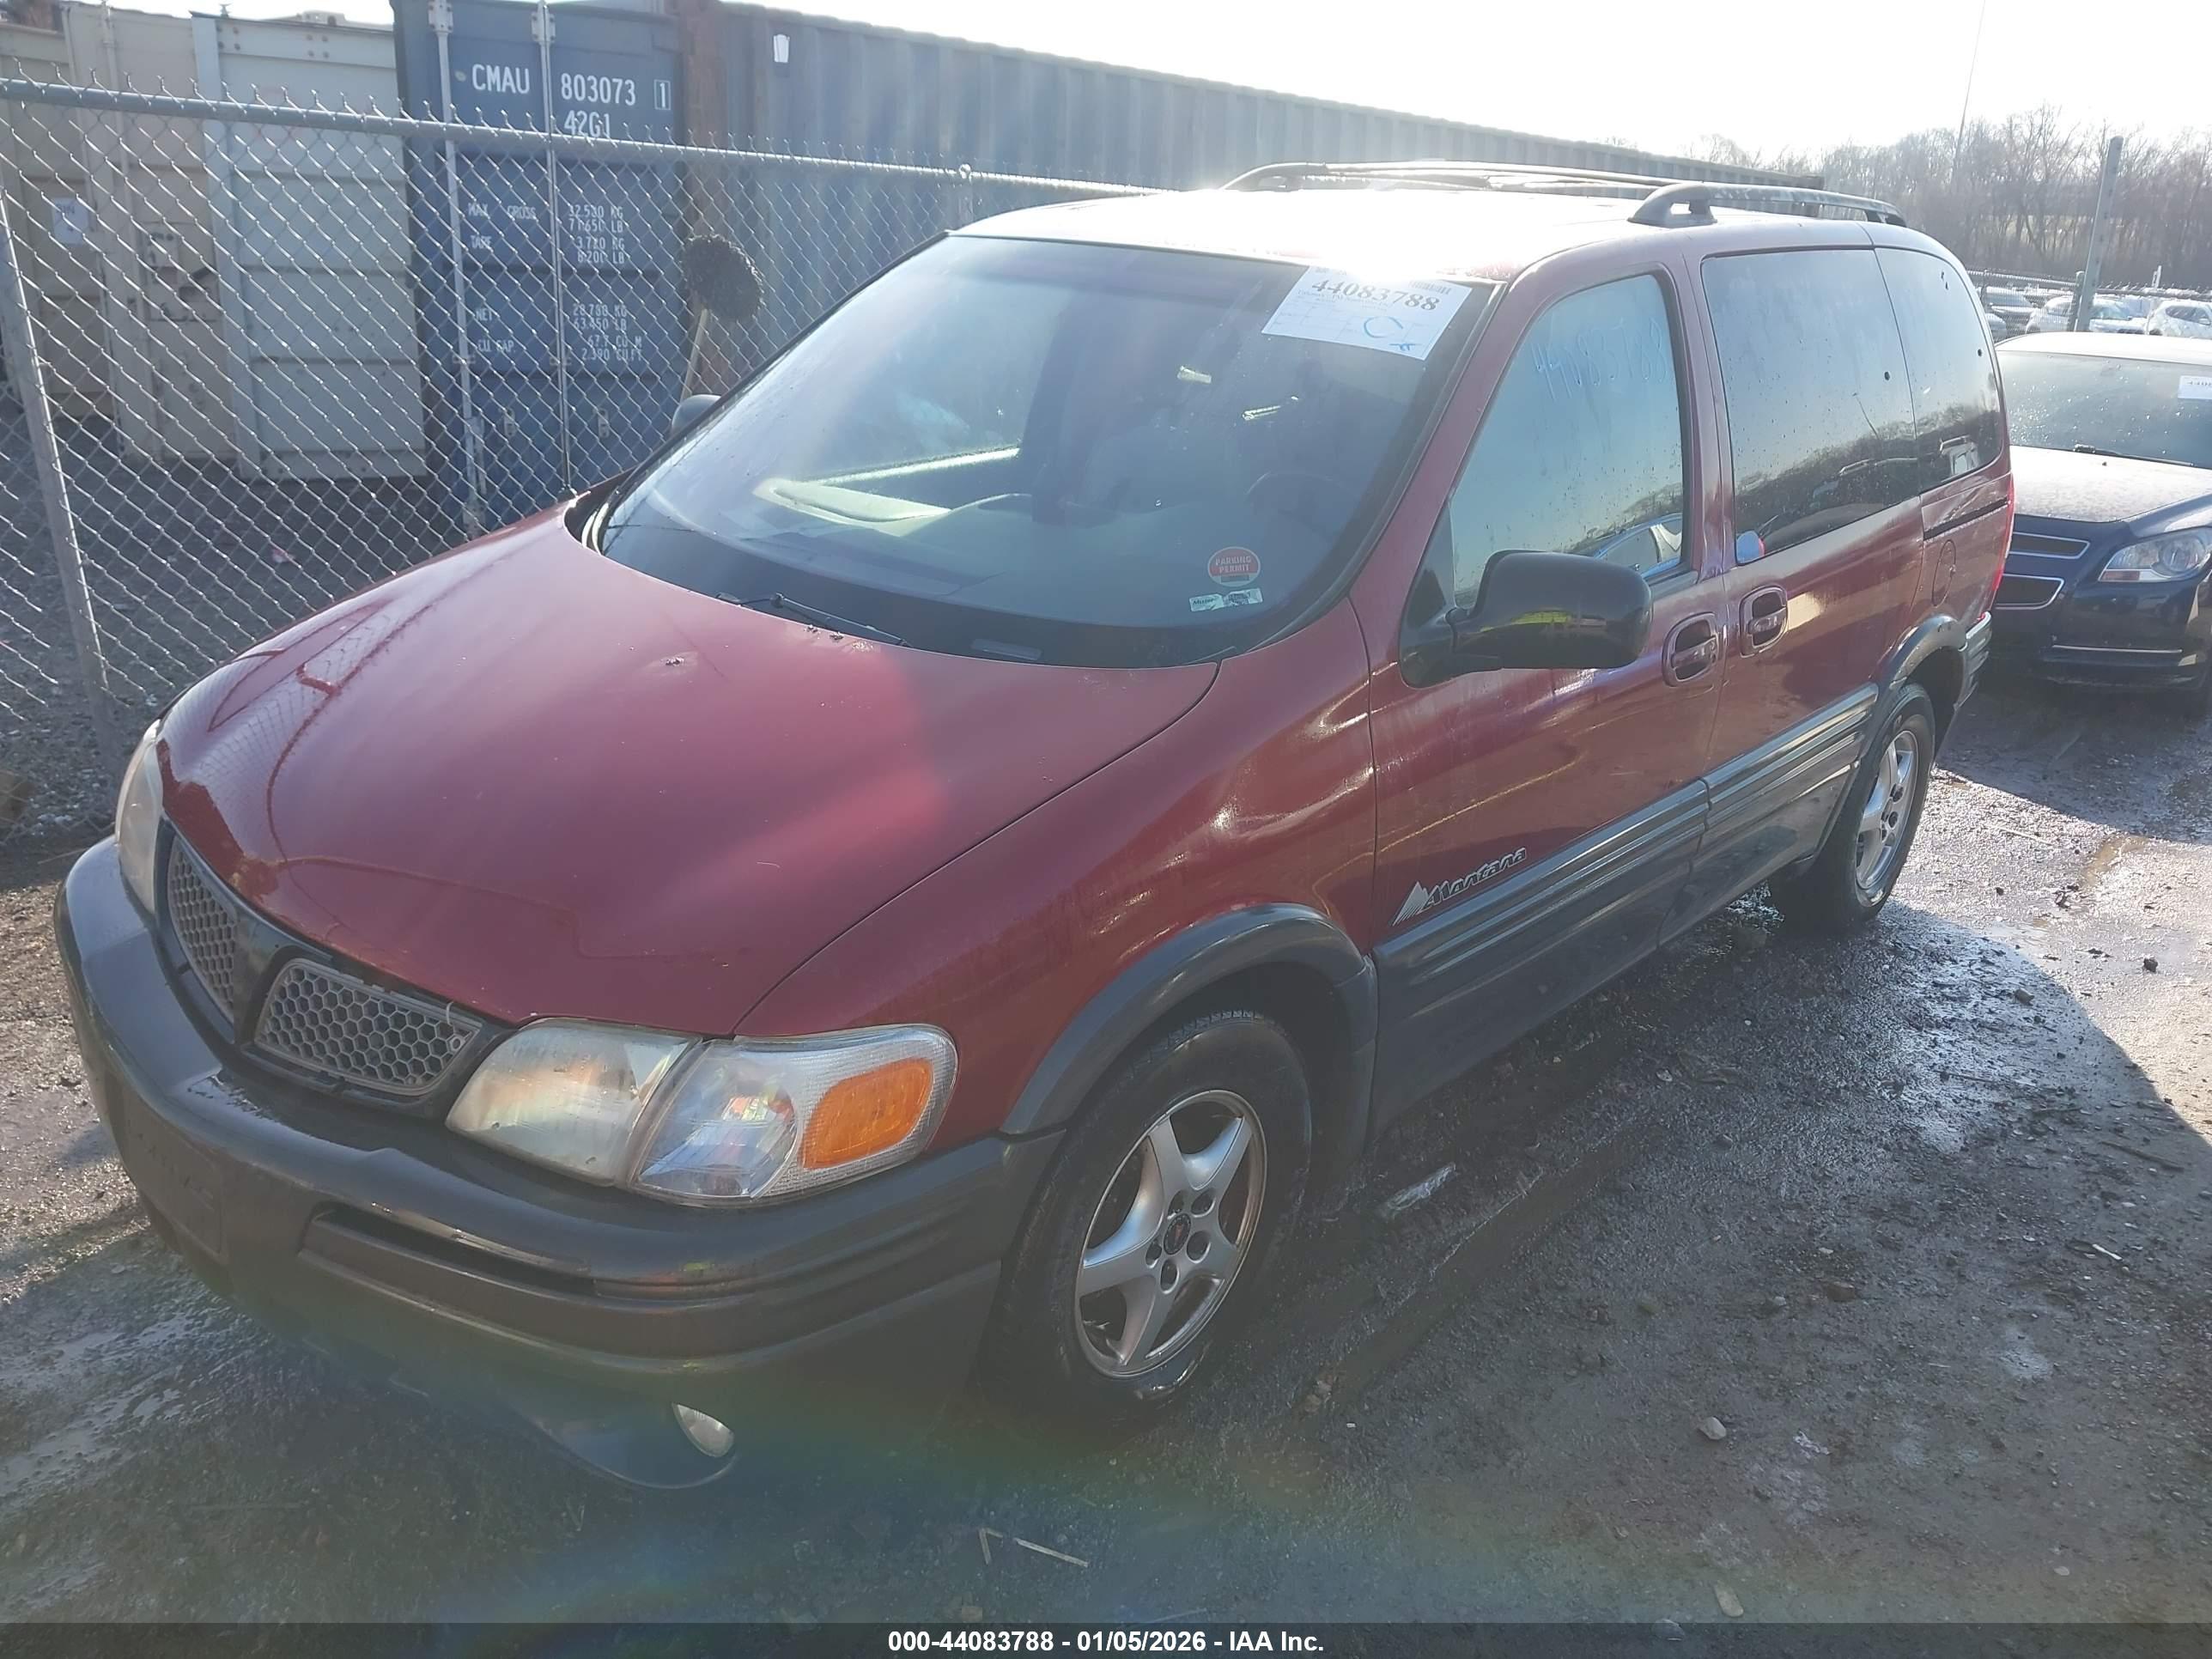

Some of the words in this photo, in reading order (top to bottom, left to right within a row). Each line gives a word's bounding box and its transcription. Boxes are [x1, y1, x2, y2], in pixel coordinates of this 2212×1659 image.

[472, 64, 531, 94] CMAU
[561, 73, 636, 106] 803073
[564, 109, 611, 138] 42G1
[468, 203, 489, 217] MAX
[611, 220, 623, 234] LB
[612, 252, 625, 264] LB
[1312, 278, 1440, 311] 44083788
[475, 307, 493, 321] NET
[1215, 556, 1252, 566] PARKING
[1219, 563, 1249, 574] PERMIT
[1416, 847, 1528, 915] Montana
